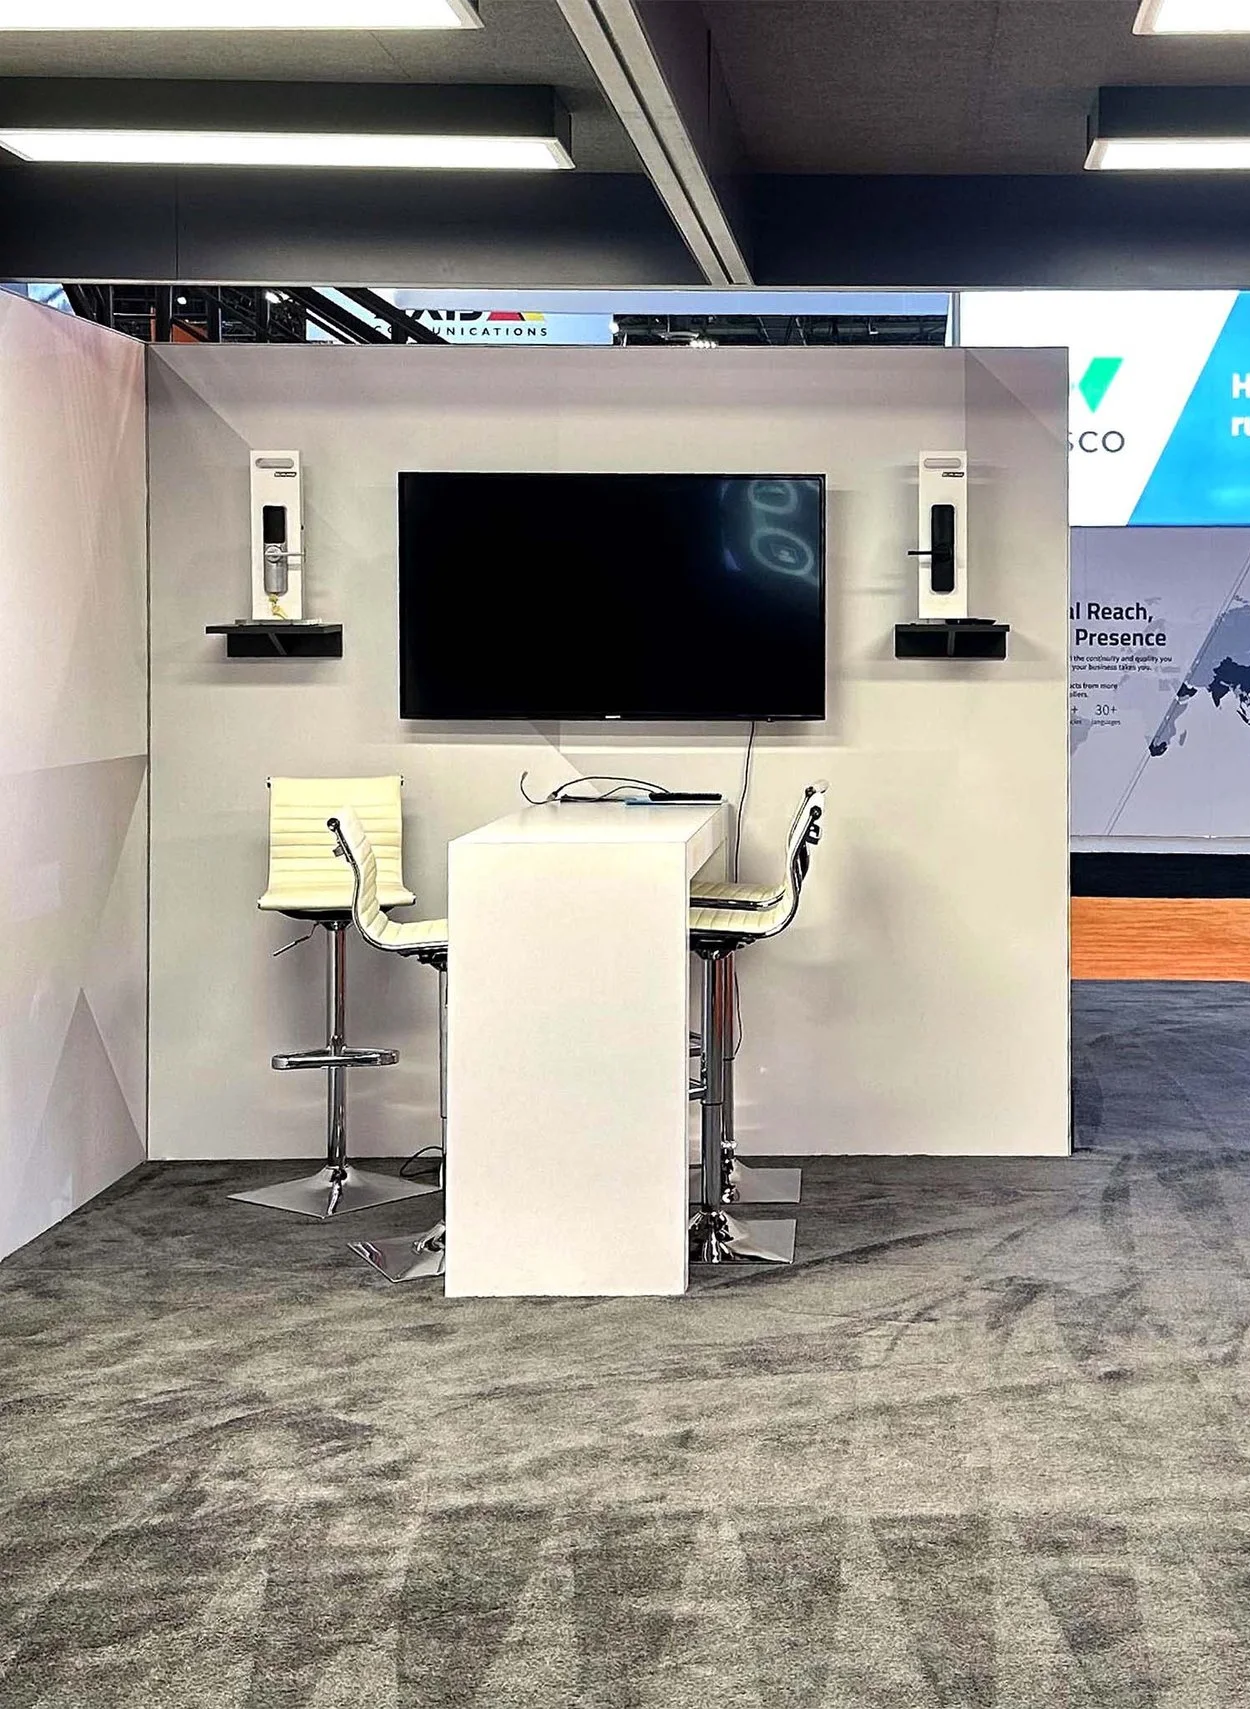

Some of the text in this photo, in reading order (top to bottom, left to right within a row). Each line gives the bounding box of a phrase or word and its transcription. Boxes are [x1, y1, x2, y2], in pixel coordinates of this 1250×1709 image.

[374, 325, 548, 336] UNICATIONS
[1088, 602, 1153, 623] Reach,
[1075, 629, 1167, 646] Presence
[1086, 655, 1120, 664] continuity
[1135, 655, 1158, 664] quality
[1095, 704, 1117, 716] 30+
